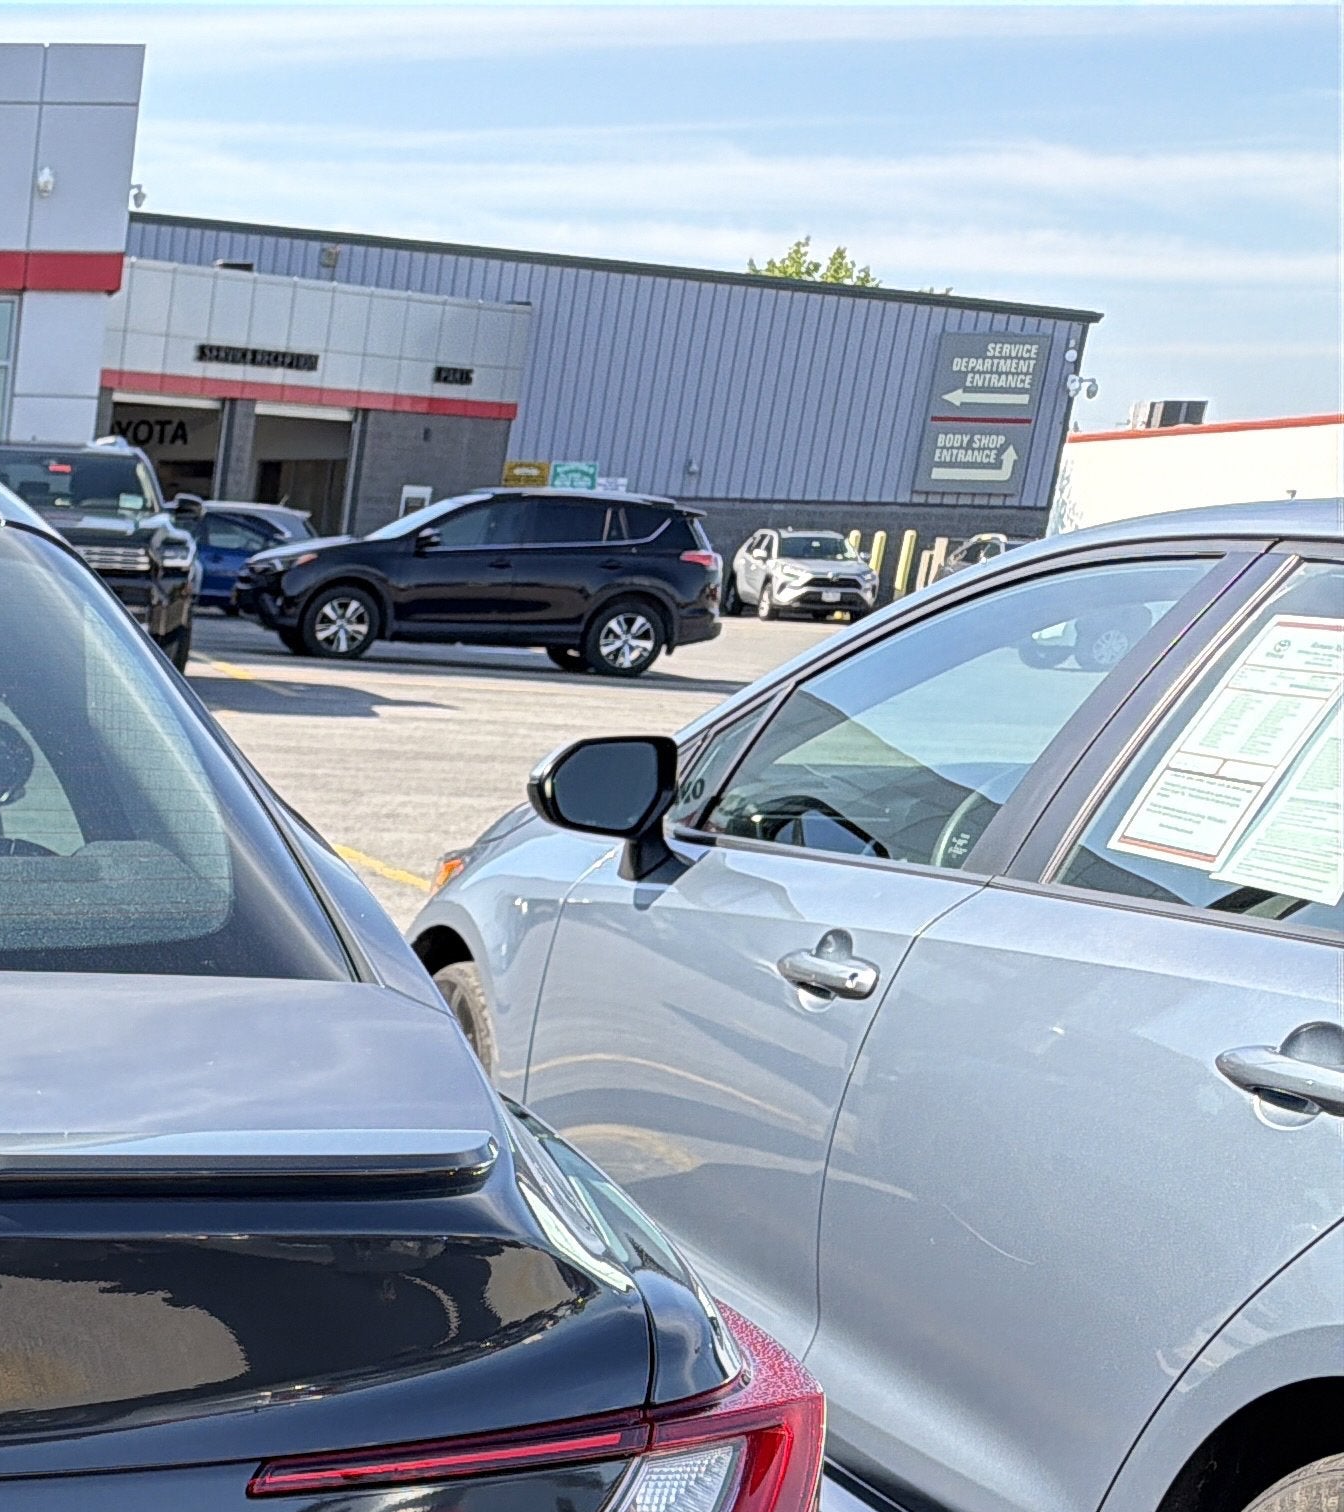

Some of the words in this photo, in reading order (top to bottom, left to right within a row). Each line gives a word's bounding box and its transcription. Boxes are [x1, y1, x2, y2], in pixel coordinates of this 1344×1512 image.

[986, 342, 1039, 358] SERVICE
[952, 357, 1037, 373] DEPARTMENT
[965, 373, 1033, 388] ENTRANCE
[111, 419, 188, 445] YOTA
[937, 433, 971, 447] BODY
[972, 434, 1006, 449] SHOP
[934, 449, 998, 463] ENTRANCE
